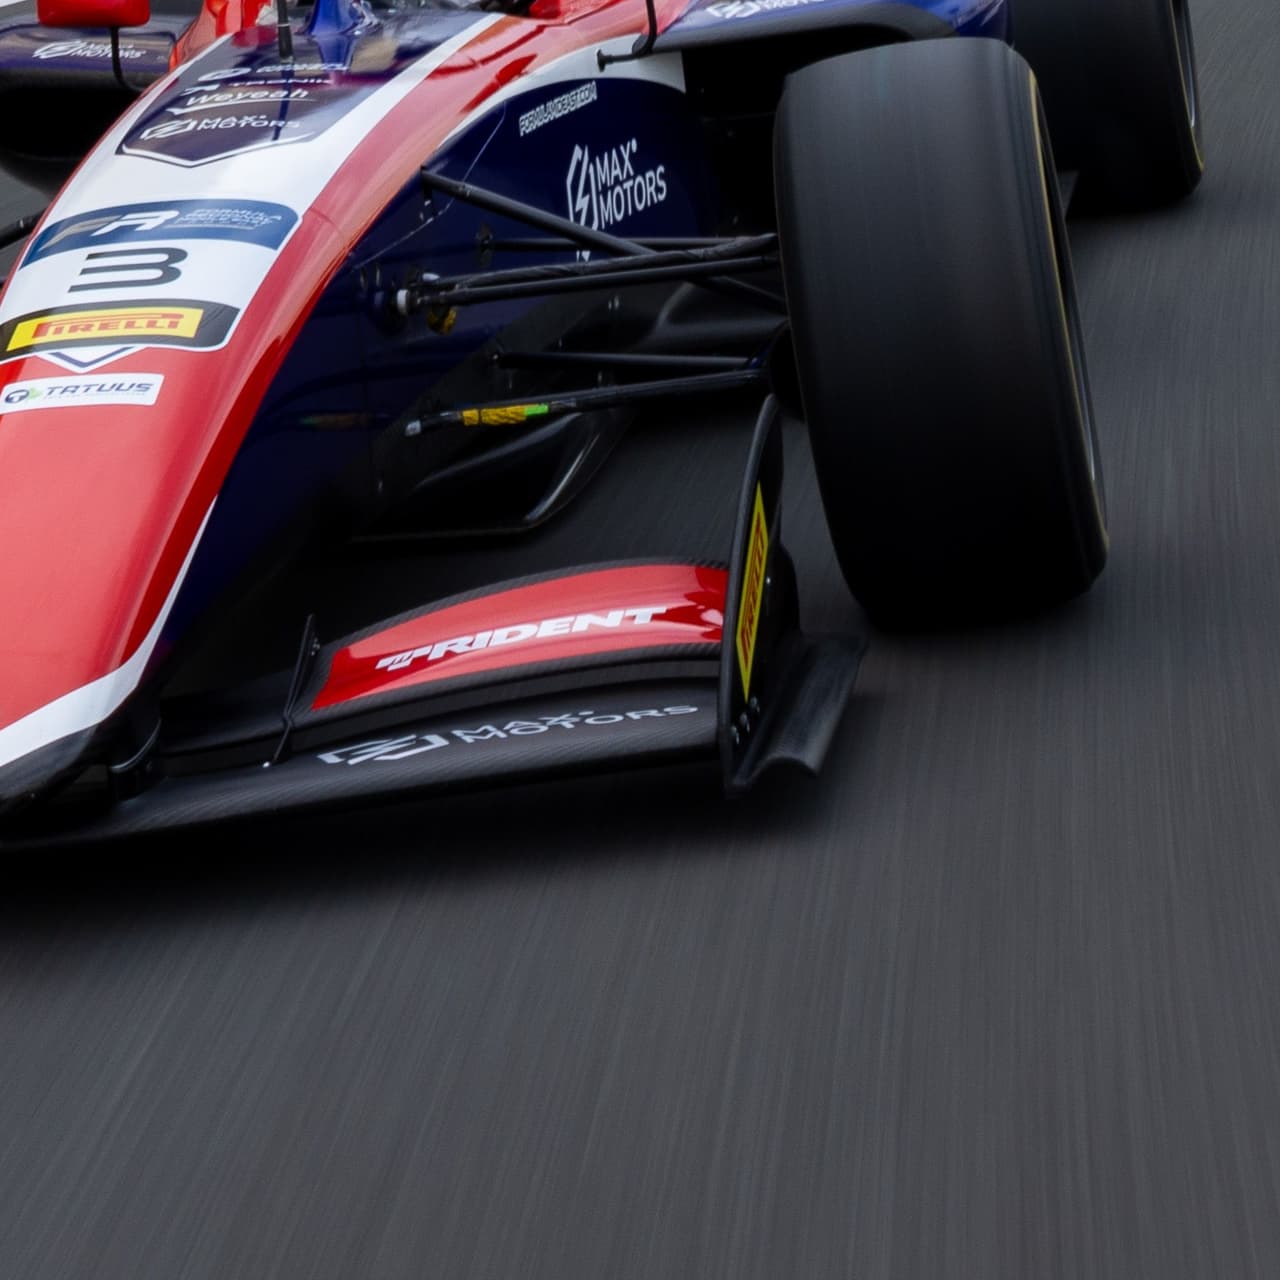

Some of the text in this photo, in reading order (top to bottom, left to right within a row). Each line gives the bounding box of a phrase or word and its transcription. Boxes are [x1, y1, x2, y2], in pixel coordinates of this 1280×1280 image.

[197, 120, 300, 130] MOTORS
[596, 141, 634, 191] MAX
[600, 165, 667, 230] MOTORS
[67, 247, 188, 293] 3
[32, 313, 184, 339] PIRELLI
[46, 382, 154, 397] TATUUS
[375, 607, 668, 672] TRIDENT
[452, 713, 581, 738] MAX
[462, 705, 699, 744] MOTORS
